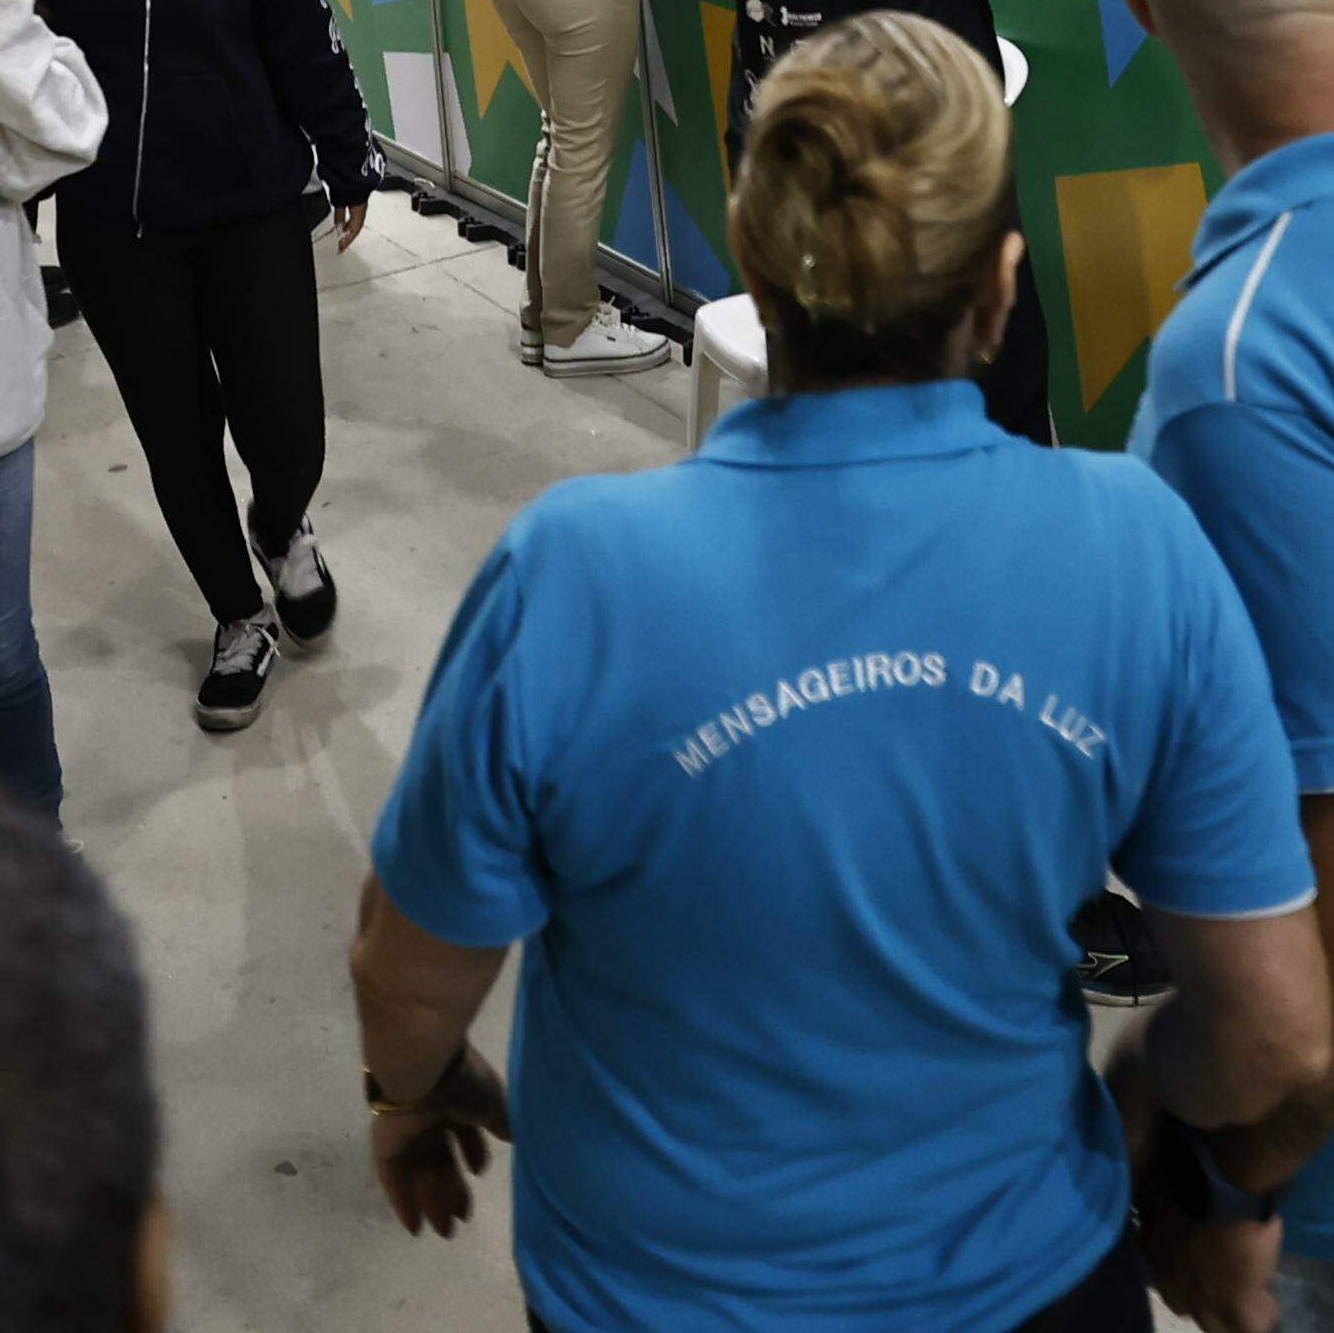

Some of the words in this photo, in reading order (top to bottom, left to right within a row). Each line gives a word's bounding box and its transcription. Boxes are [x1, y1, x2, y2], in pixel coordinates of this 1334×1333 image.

[672, 650, 948, 779] MENSAGEIROS
[971, 660, 1025, 712] DA
[1038, 693, 1107, 759] LUZ
